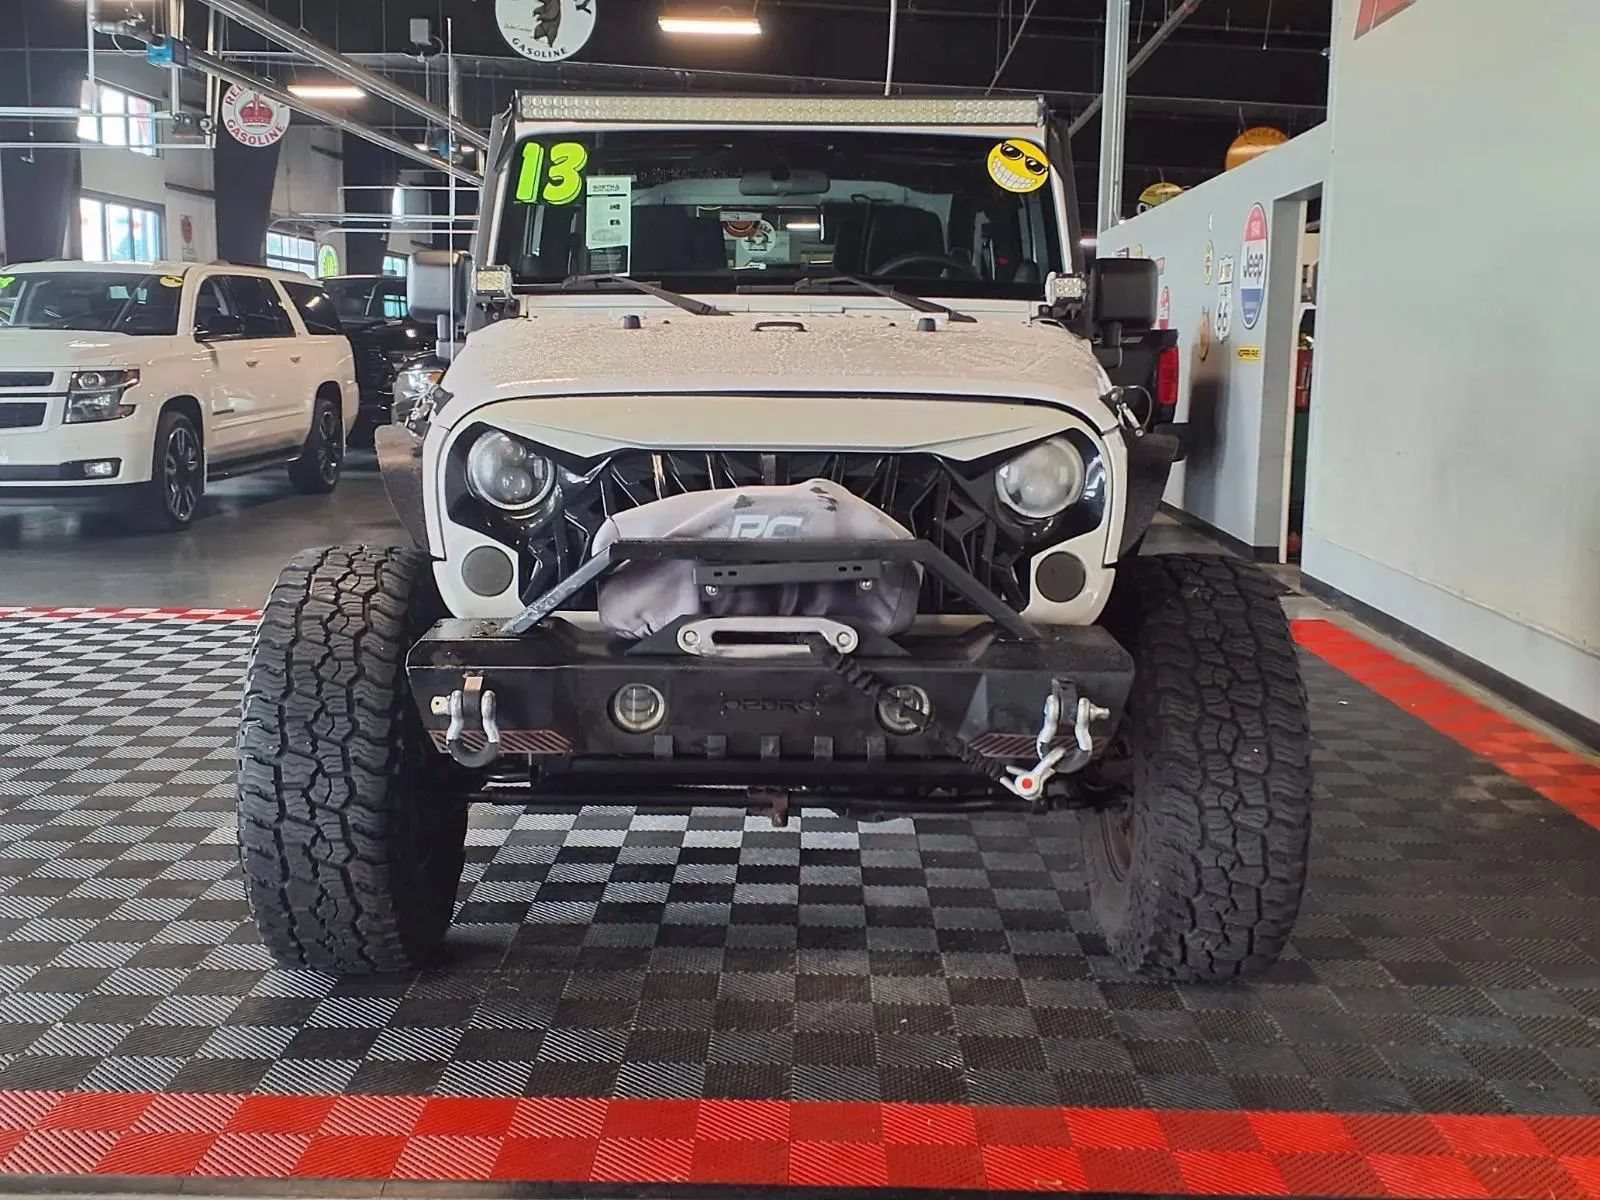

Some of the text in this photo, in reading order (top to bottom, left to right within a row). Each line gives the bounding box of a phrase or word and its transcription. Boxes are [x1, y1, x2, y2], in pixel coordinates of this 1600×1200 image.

[512, 37, 568, 58] GASOLINE
[226, 118, 286, 145] GASOLINE
[515, 141, 588, 206] 13
[1242, 247, 1264, 285] Jeep
[1216, 301, 1229, 332] 66
